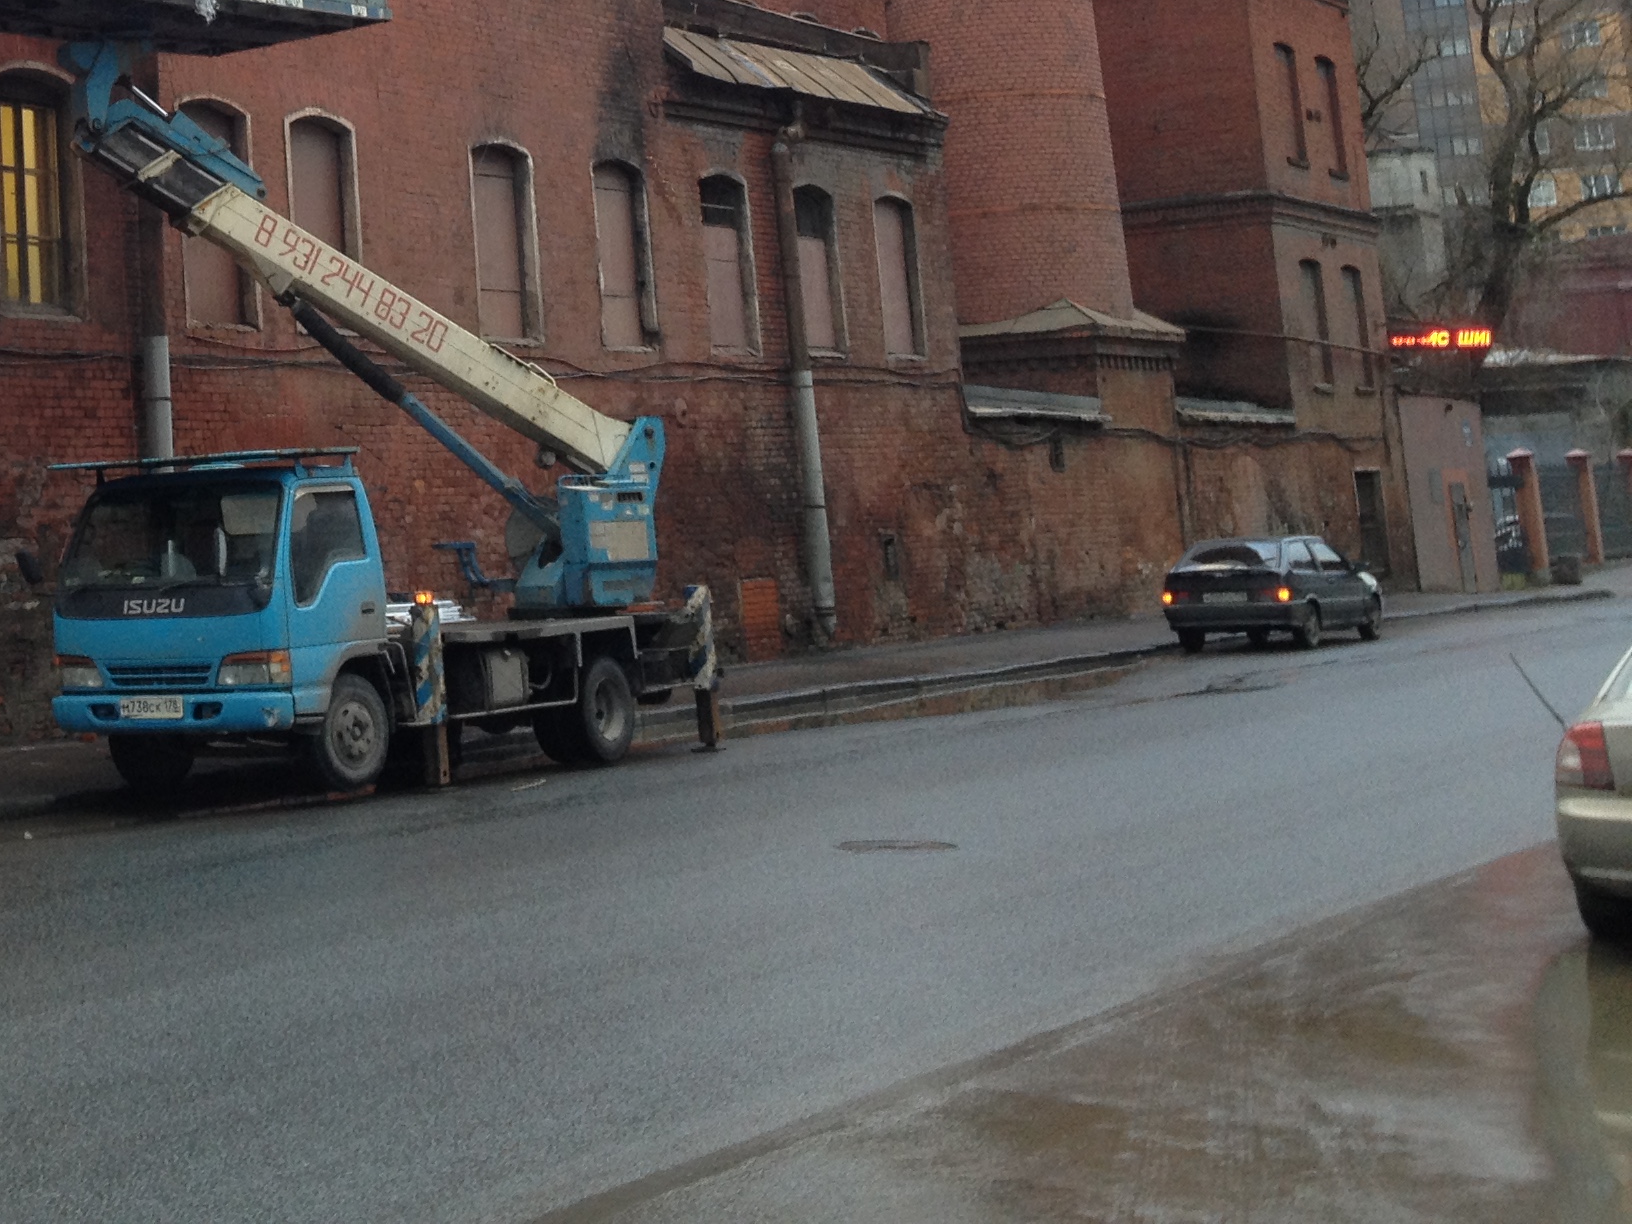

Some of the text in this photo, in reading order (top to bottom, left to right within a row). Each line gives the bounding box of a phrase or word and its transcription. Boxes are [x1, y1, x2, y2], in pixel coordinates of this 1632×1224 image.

[254, 214, 448, 354] 8 931 244 83 20
[123, 598, 185, 615] ISUZU
